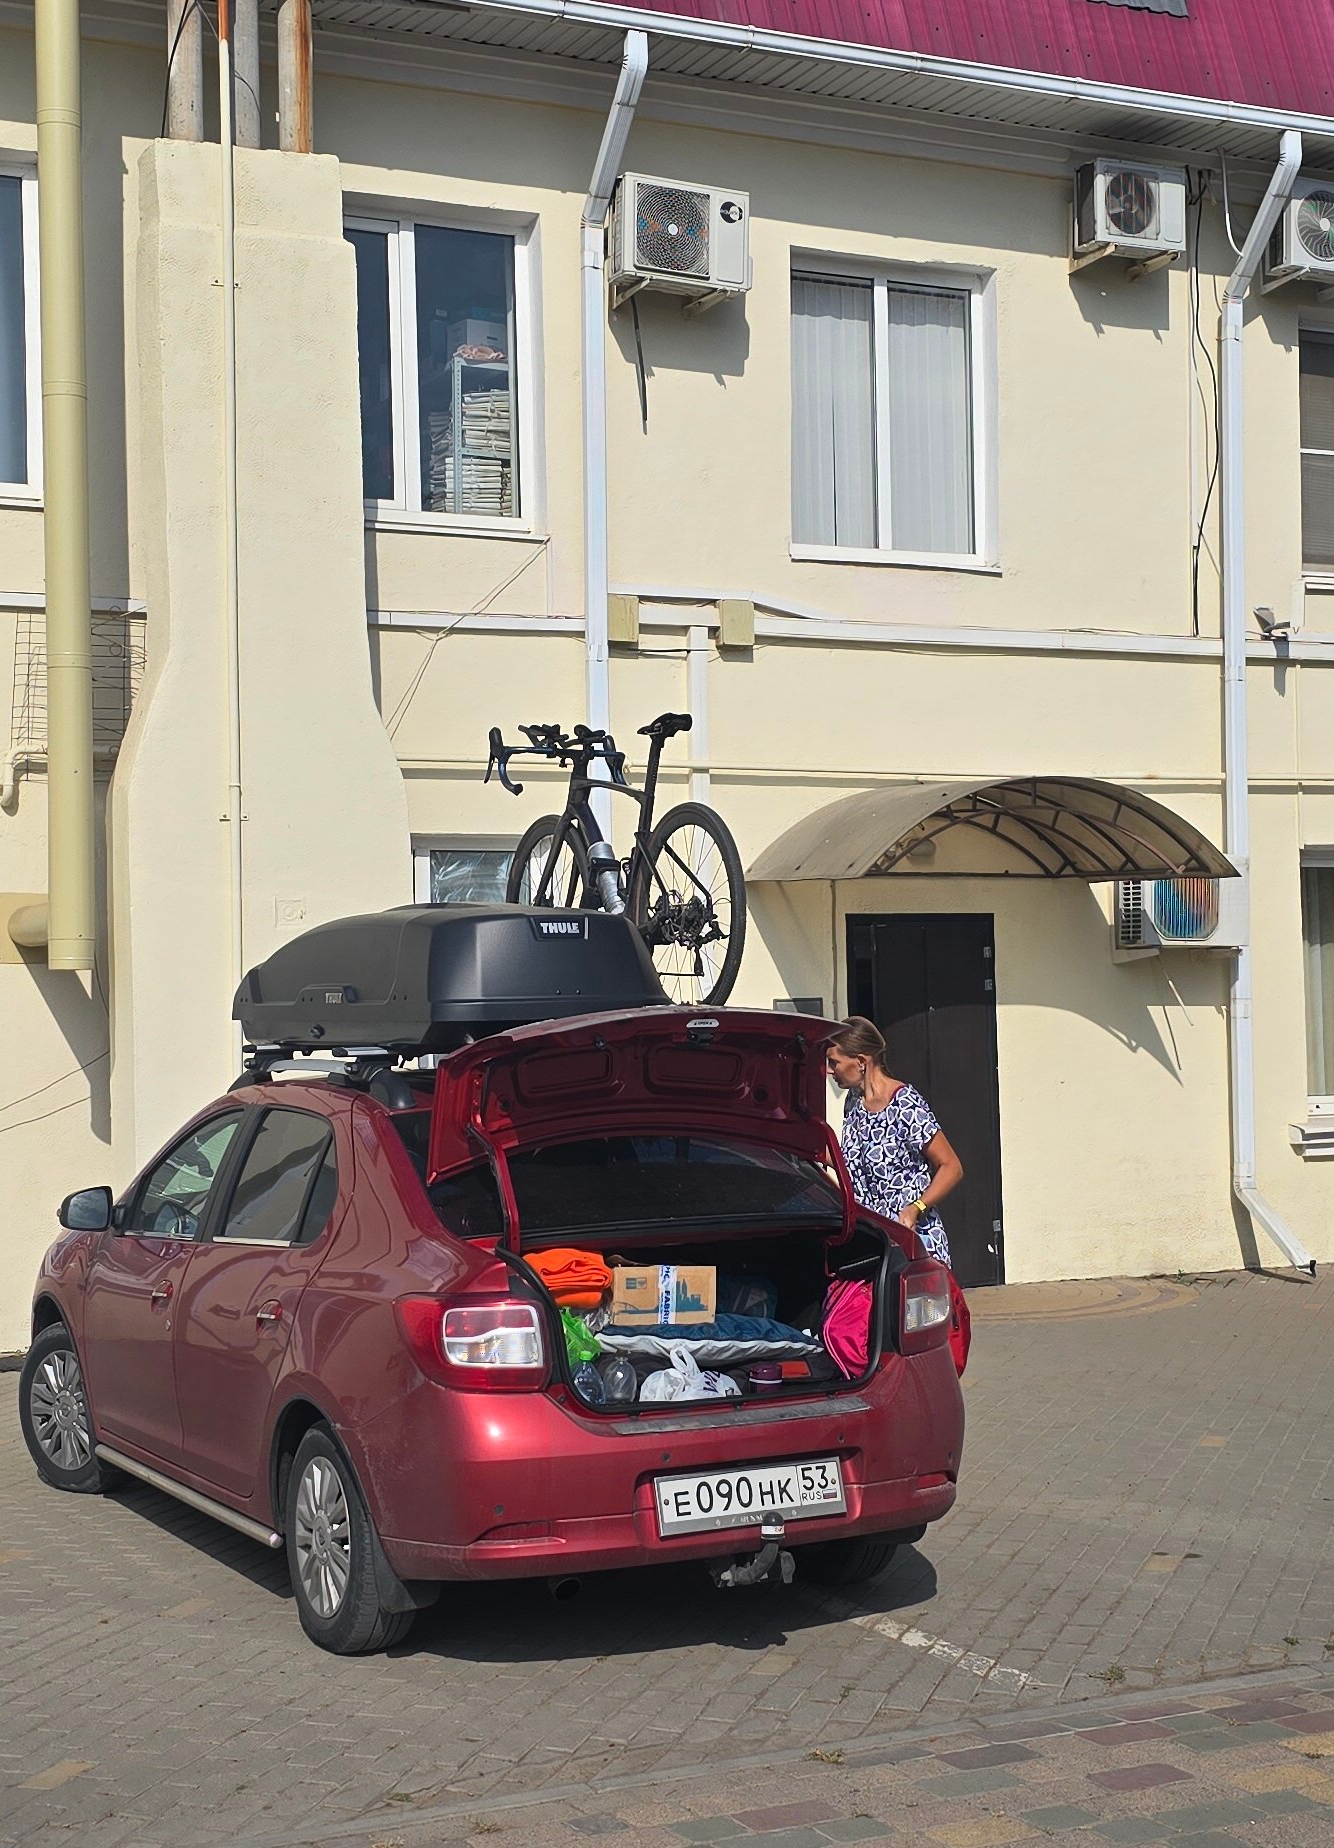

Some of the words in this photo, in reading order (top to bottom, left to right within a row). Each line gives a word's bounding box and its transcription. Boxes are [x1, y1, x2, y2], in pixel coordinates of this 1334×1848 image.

[540, 922, 580, 934] THULE
[801, 1464, 829, 1491] 53
[802, 1490, 822, 1501] RUS
